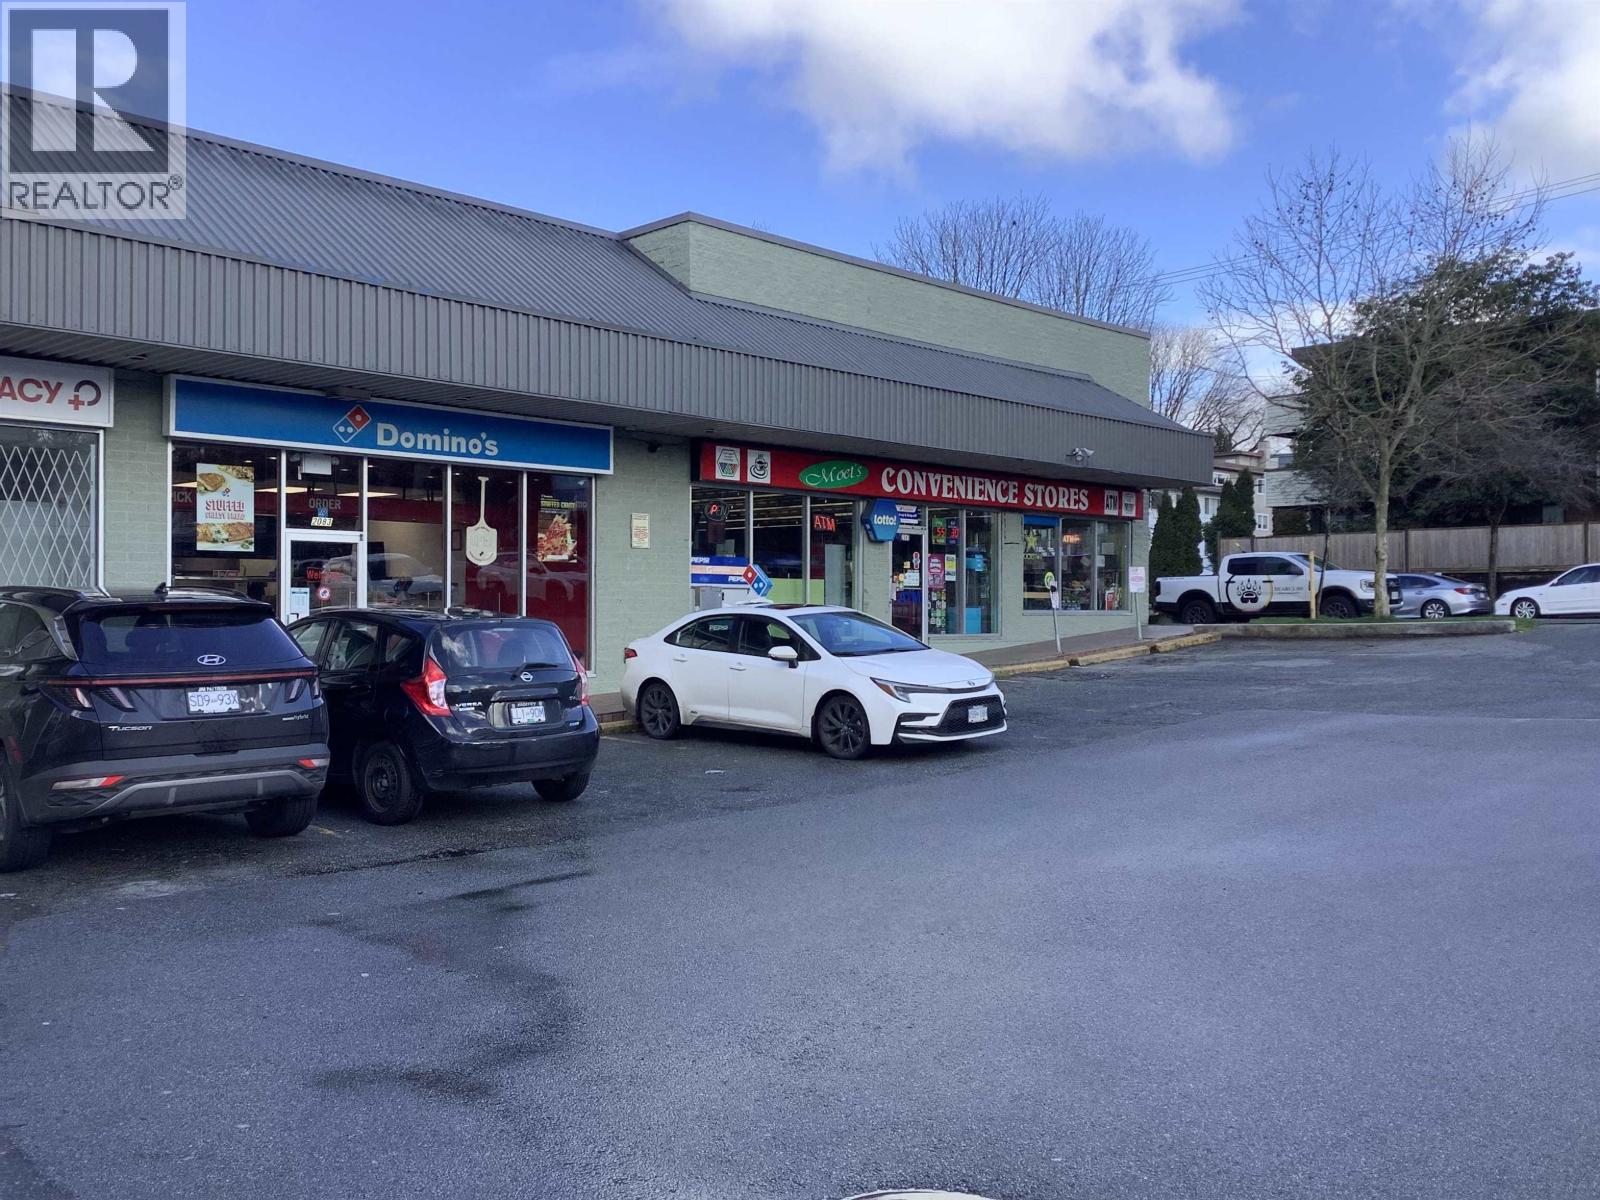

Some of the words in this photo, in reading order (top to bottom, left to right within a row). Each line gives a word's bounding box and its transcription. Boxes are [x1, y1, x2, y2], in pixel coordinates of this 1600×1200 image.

[376, 423, 499, 456] Domino's
[881, 467, 1018, 504] CONVENIENCE
[1023, 483, 1089, 511] STORES
[308, 498, 342, 509] ORDER
[814, 515, 836, 532] ATM
[874, 513, 897, 526] lotto!
